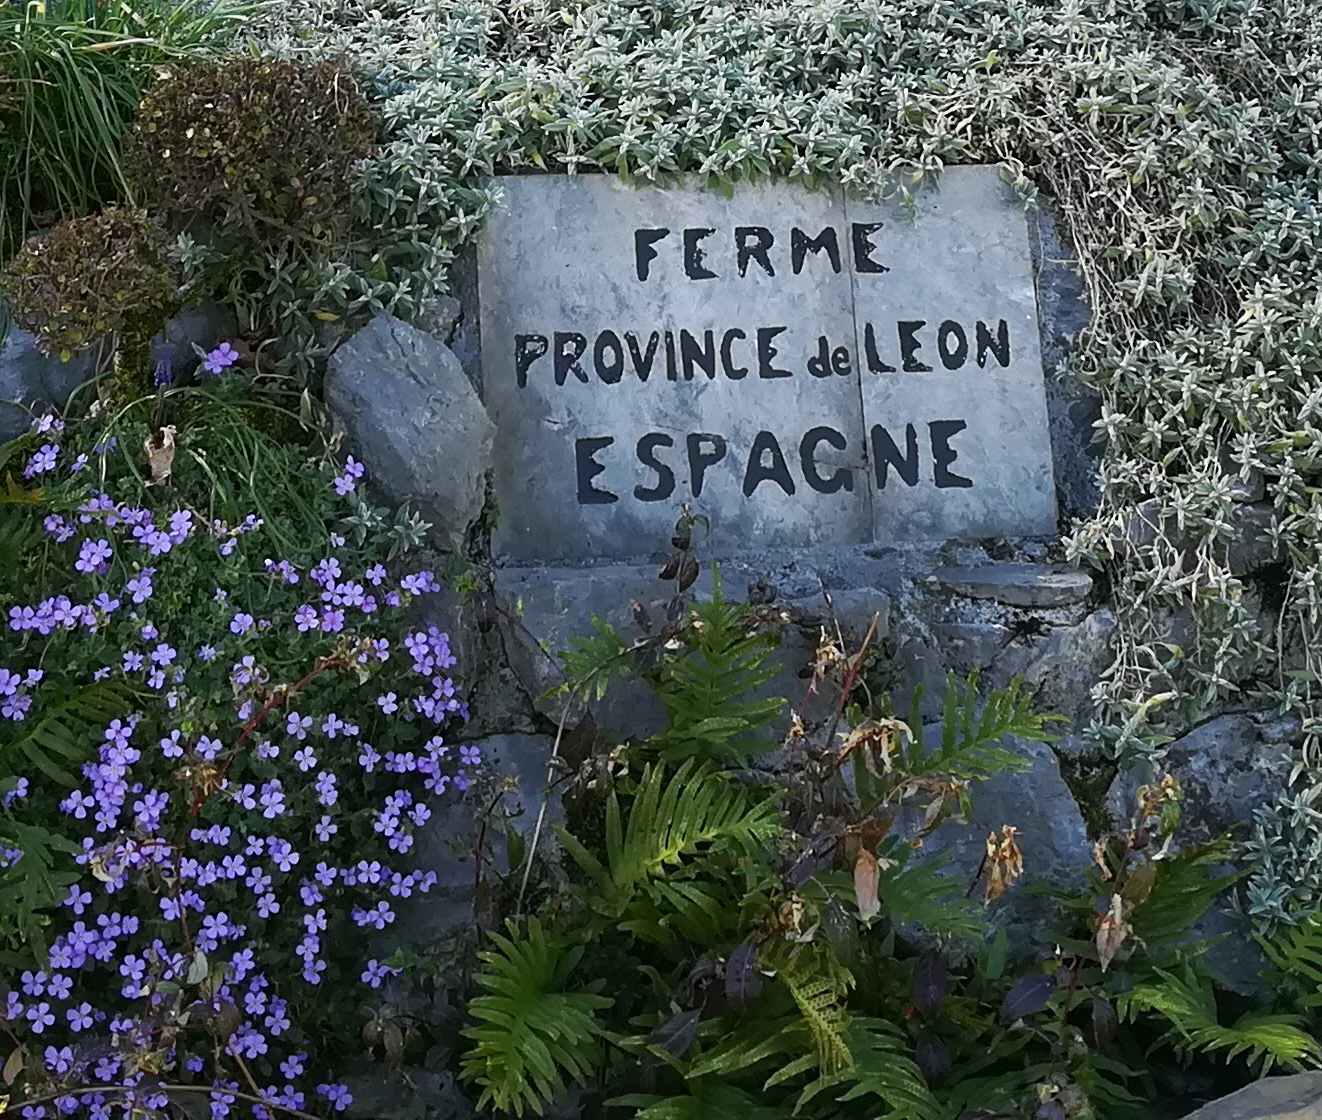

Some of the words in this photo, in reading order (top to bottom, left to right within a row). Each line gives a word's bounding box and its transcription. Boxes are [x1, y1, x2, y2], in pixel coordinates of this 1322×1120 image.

[634, 221, 891, 281] FERME
[513, 325, 793, 389] PROVINCE
[806, 334, 853, 379] de
[864, 319, 1011, 374] LEON
[575, 419, 975, 505] ESPAGNE
